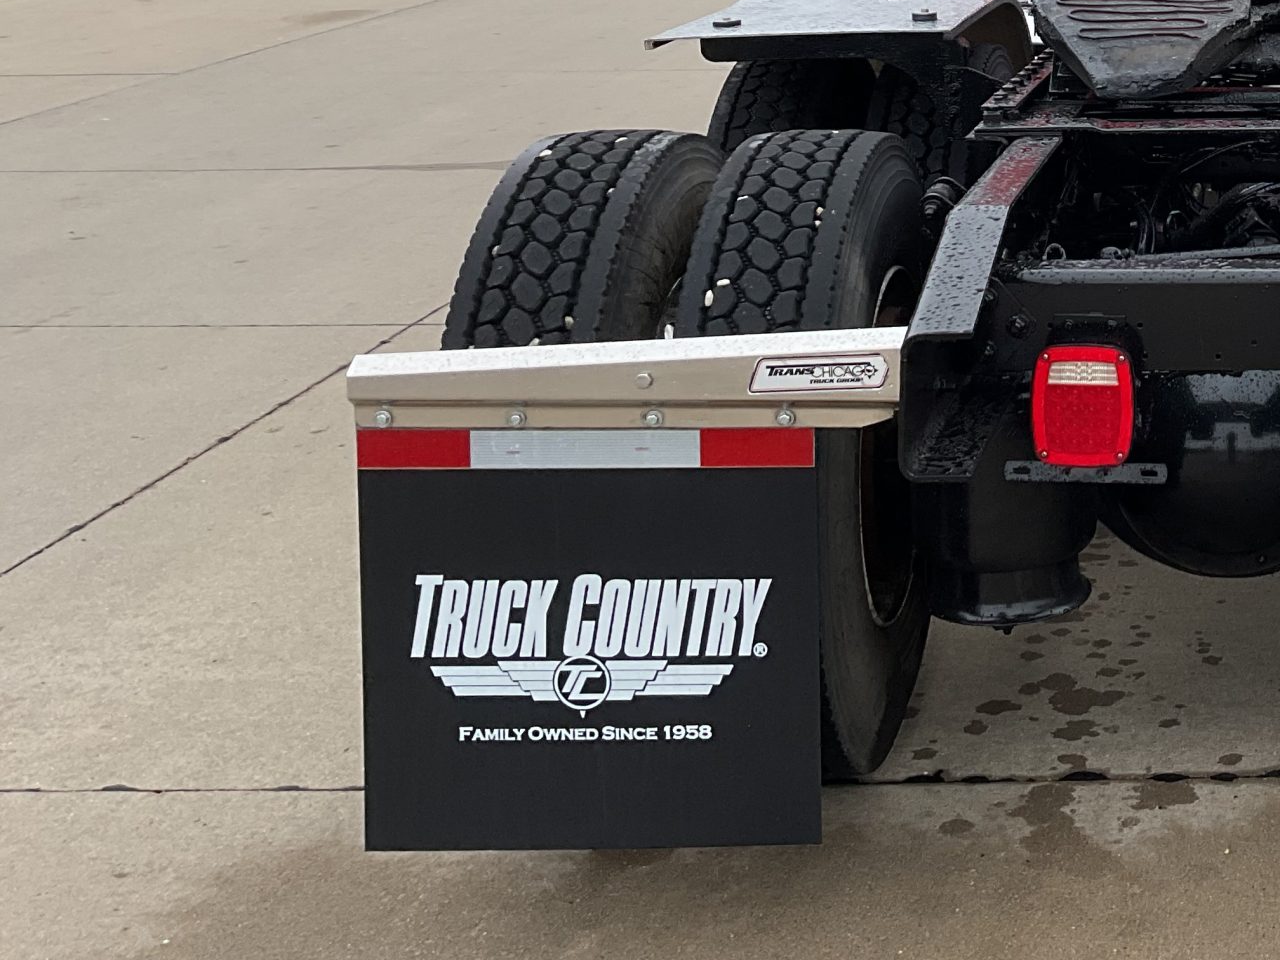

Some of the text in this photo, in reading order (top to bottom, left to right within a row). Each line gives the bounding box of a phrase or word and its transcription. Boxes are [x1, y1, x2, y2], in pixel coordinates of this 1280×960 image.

[410, 574, 773, 658] TRUCK COUNTRY
[458, 724, 713, 742] FAMILY OWNED SINCE 1958
